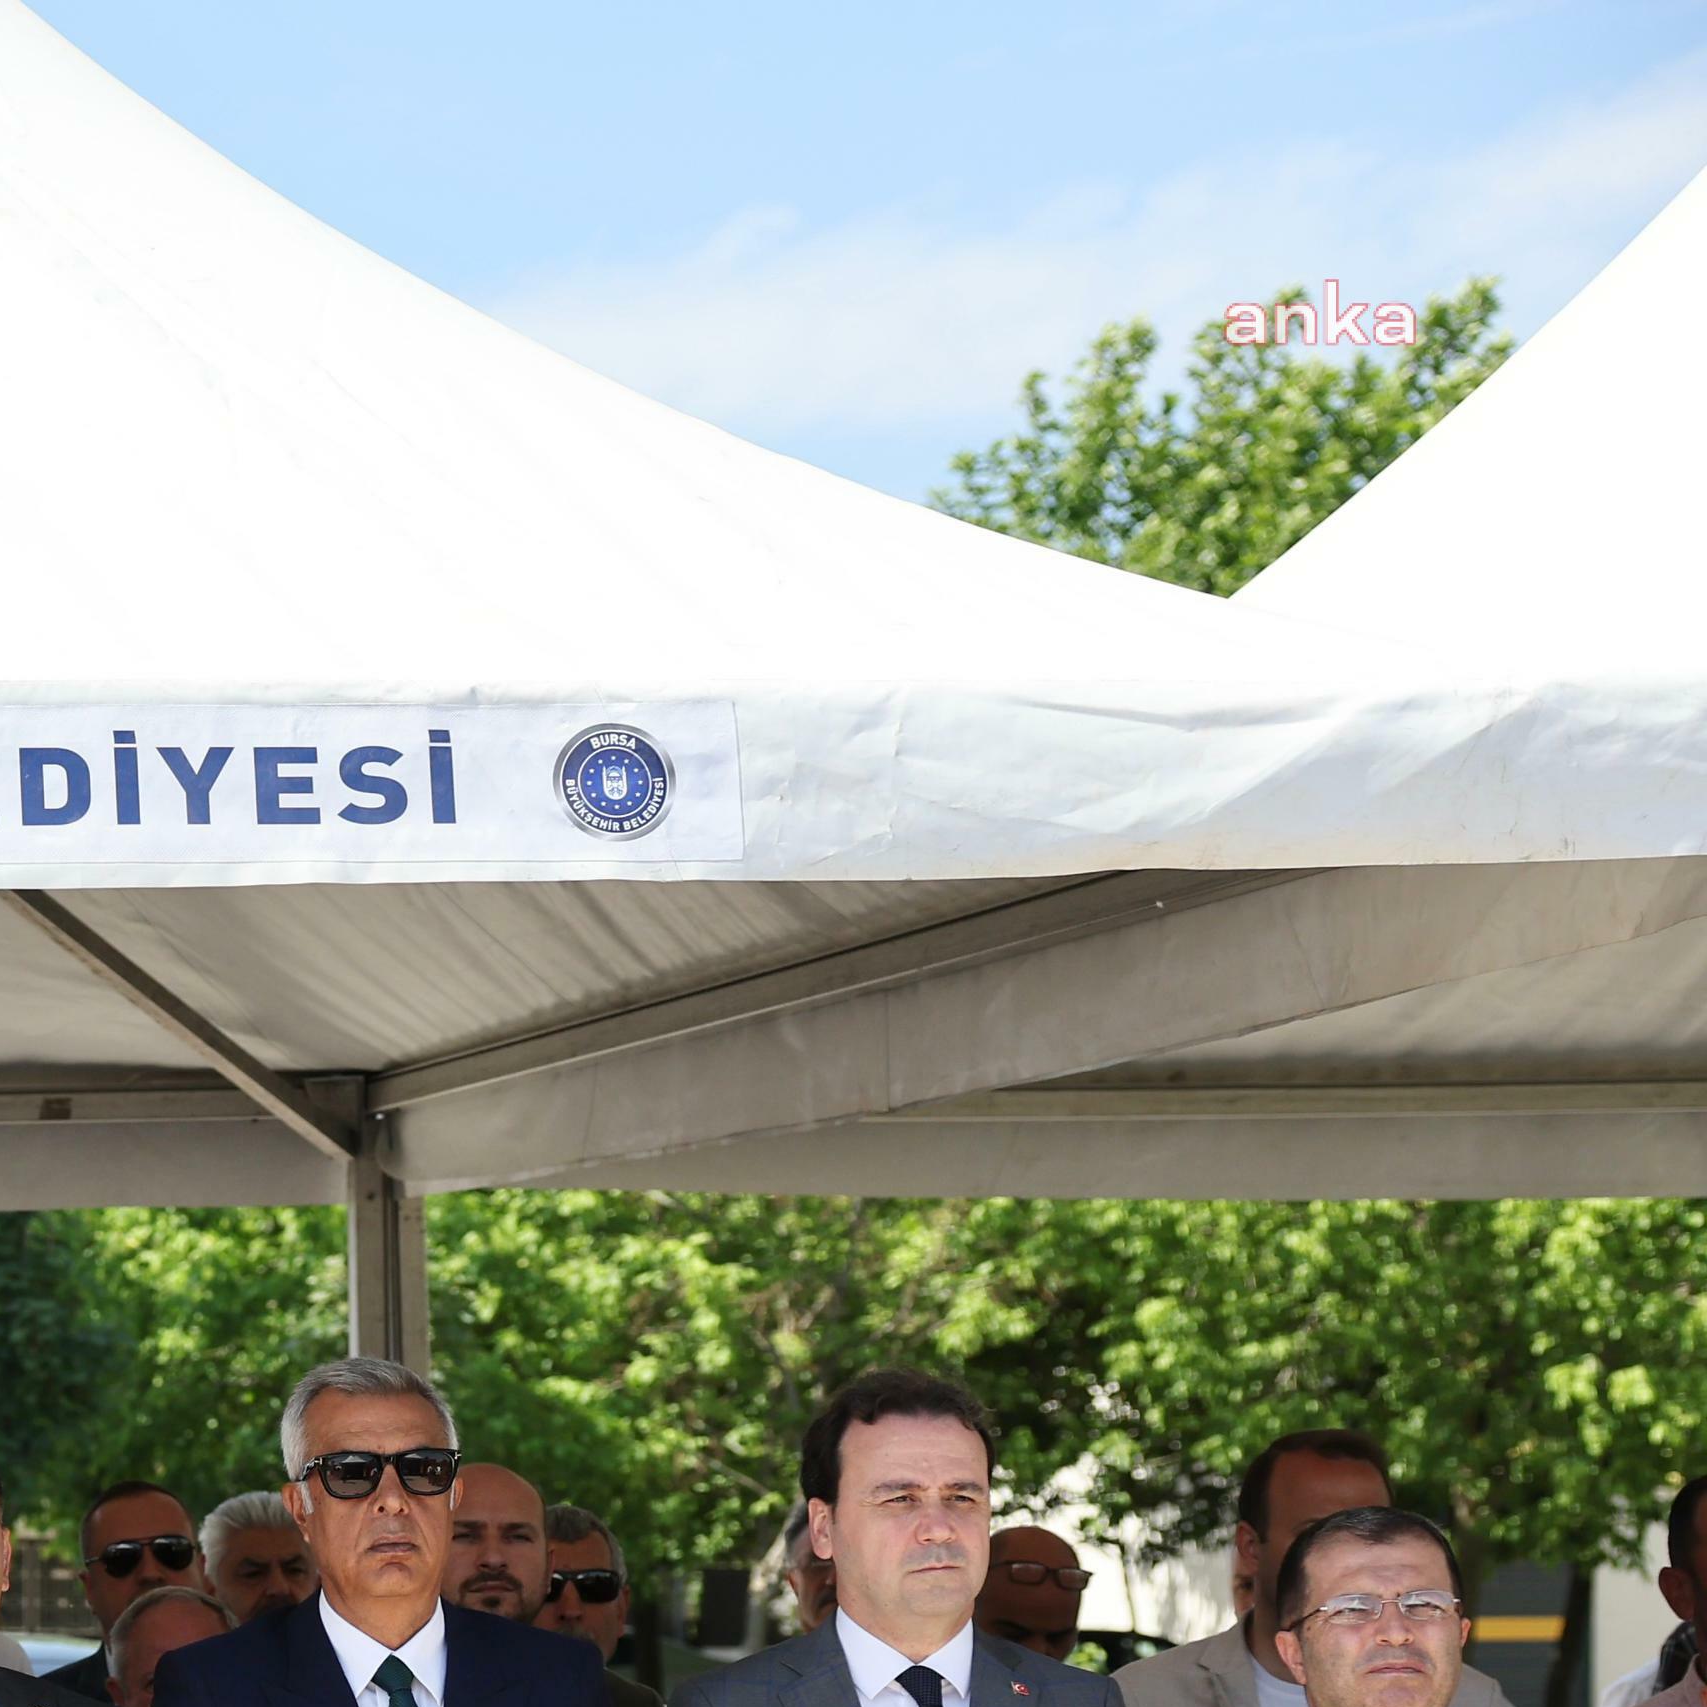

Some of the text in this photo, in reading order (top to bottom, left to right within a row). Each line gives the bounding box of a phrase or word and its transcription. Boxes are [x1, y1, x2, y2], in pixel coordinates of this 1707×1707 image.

[589, 733, 637, 749] BURSA
[565, 777, 665, 831] BÜYÜKŞEHİR BELEDİYESİ
